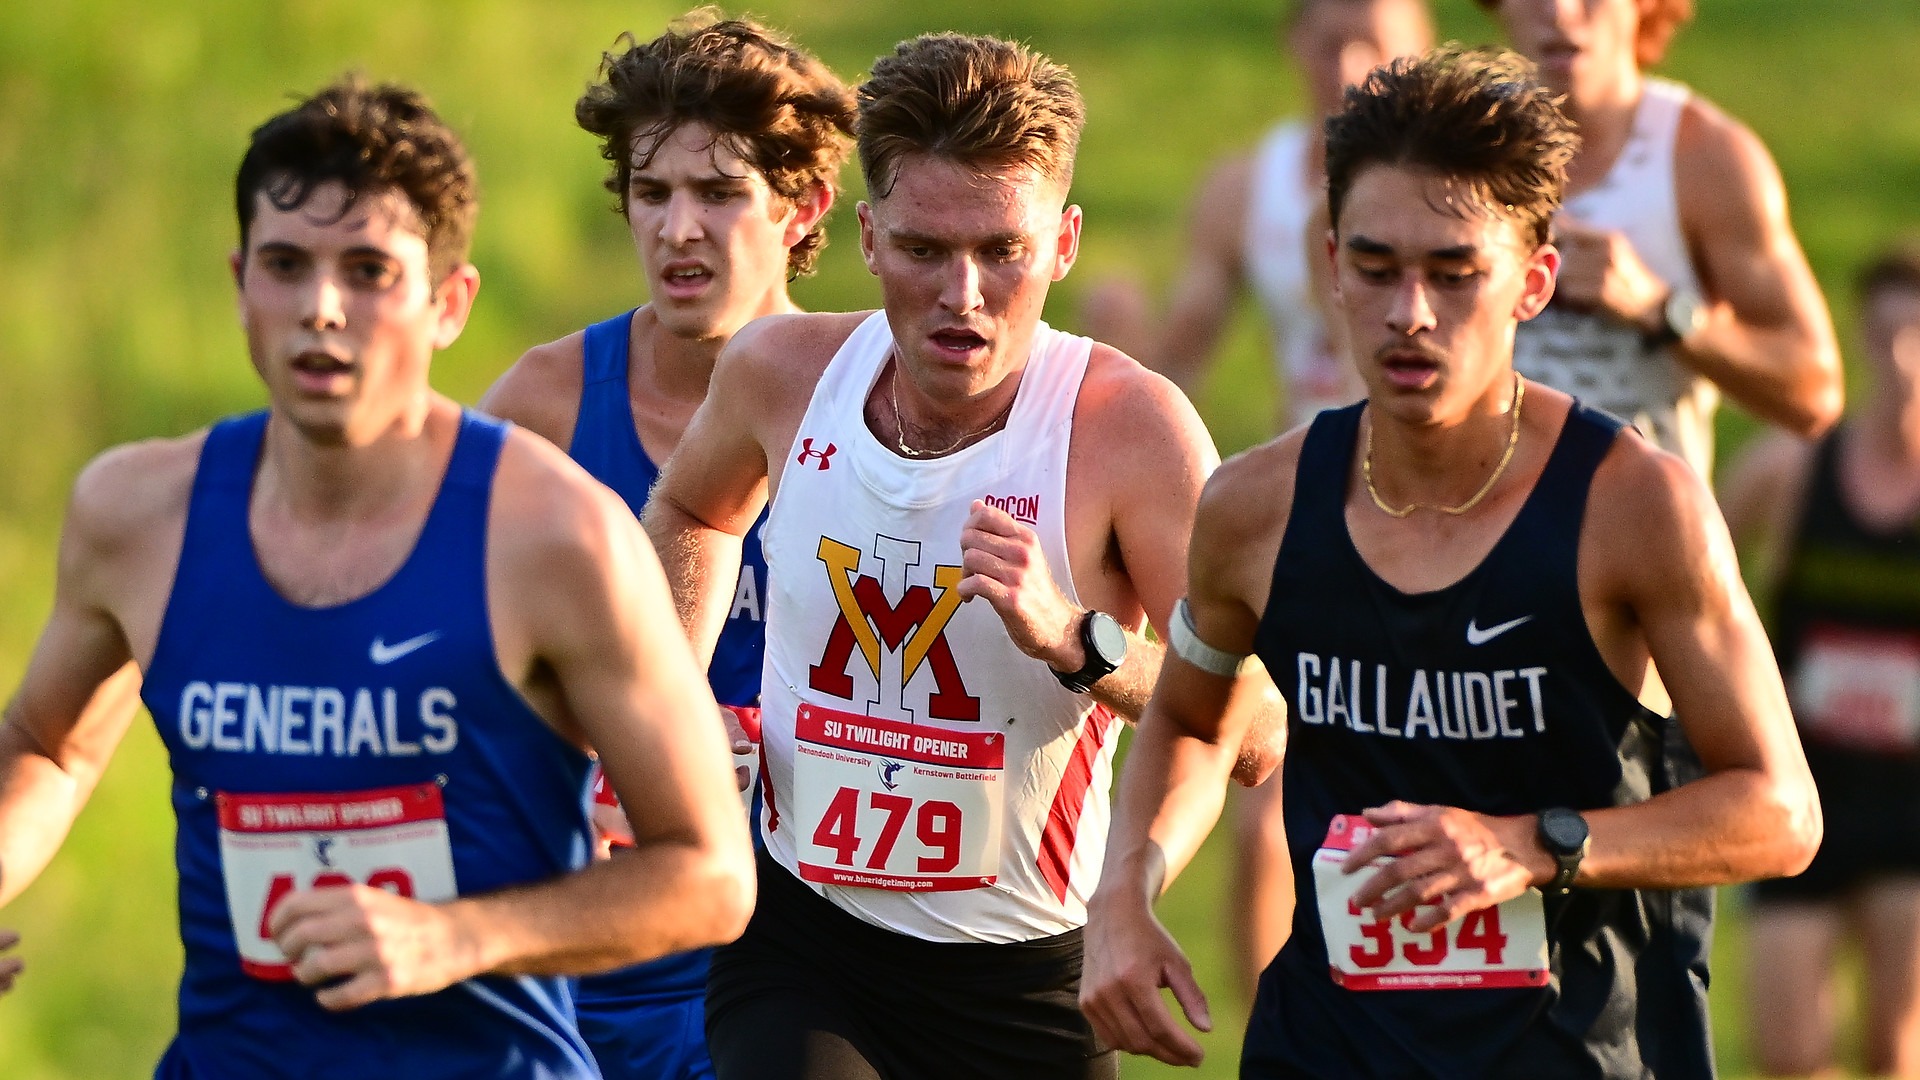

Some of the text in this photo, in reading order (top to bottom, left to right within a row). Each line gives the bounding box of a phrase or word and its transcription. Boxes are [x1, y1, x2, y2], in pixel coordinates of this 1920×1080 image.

[1298, 651, 1548, 740] GALLAUDET
[179, 681, 459, 757] GENERALS
[797, 744, 872, 768] Shenandoah University
[824, 720, 968, 760] SU TWILIGHT OPENER
[913, 766, 997, 782] Kernstown Battlefield
[812, 786, 962, 874] 479
[834, 872, 934, 889] www.blueridgetiming.com
